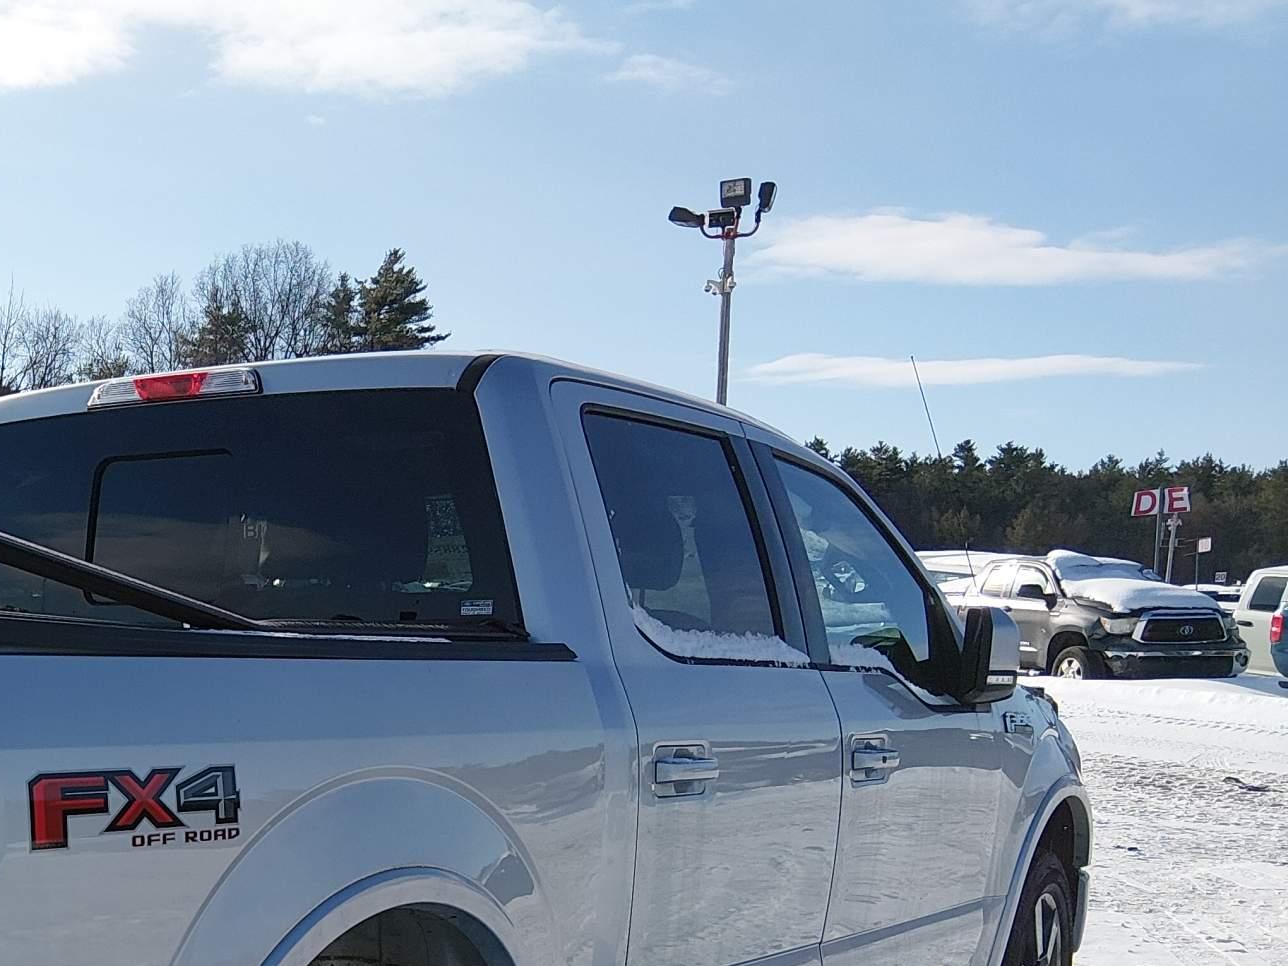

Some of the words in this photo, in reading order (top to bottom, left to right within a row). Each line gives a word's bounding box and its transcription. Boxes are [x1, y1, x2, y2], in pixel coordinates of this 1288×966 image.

[27, 765, 241, 851] FX4
[131, 832, 176, 848] OFF
[184, 827, 241, 844] ROAD
